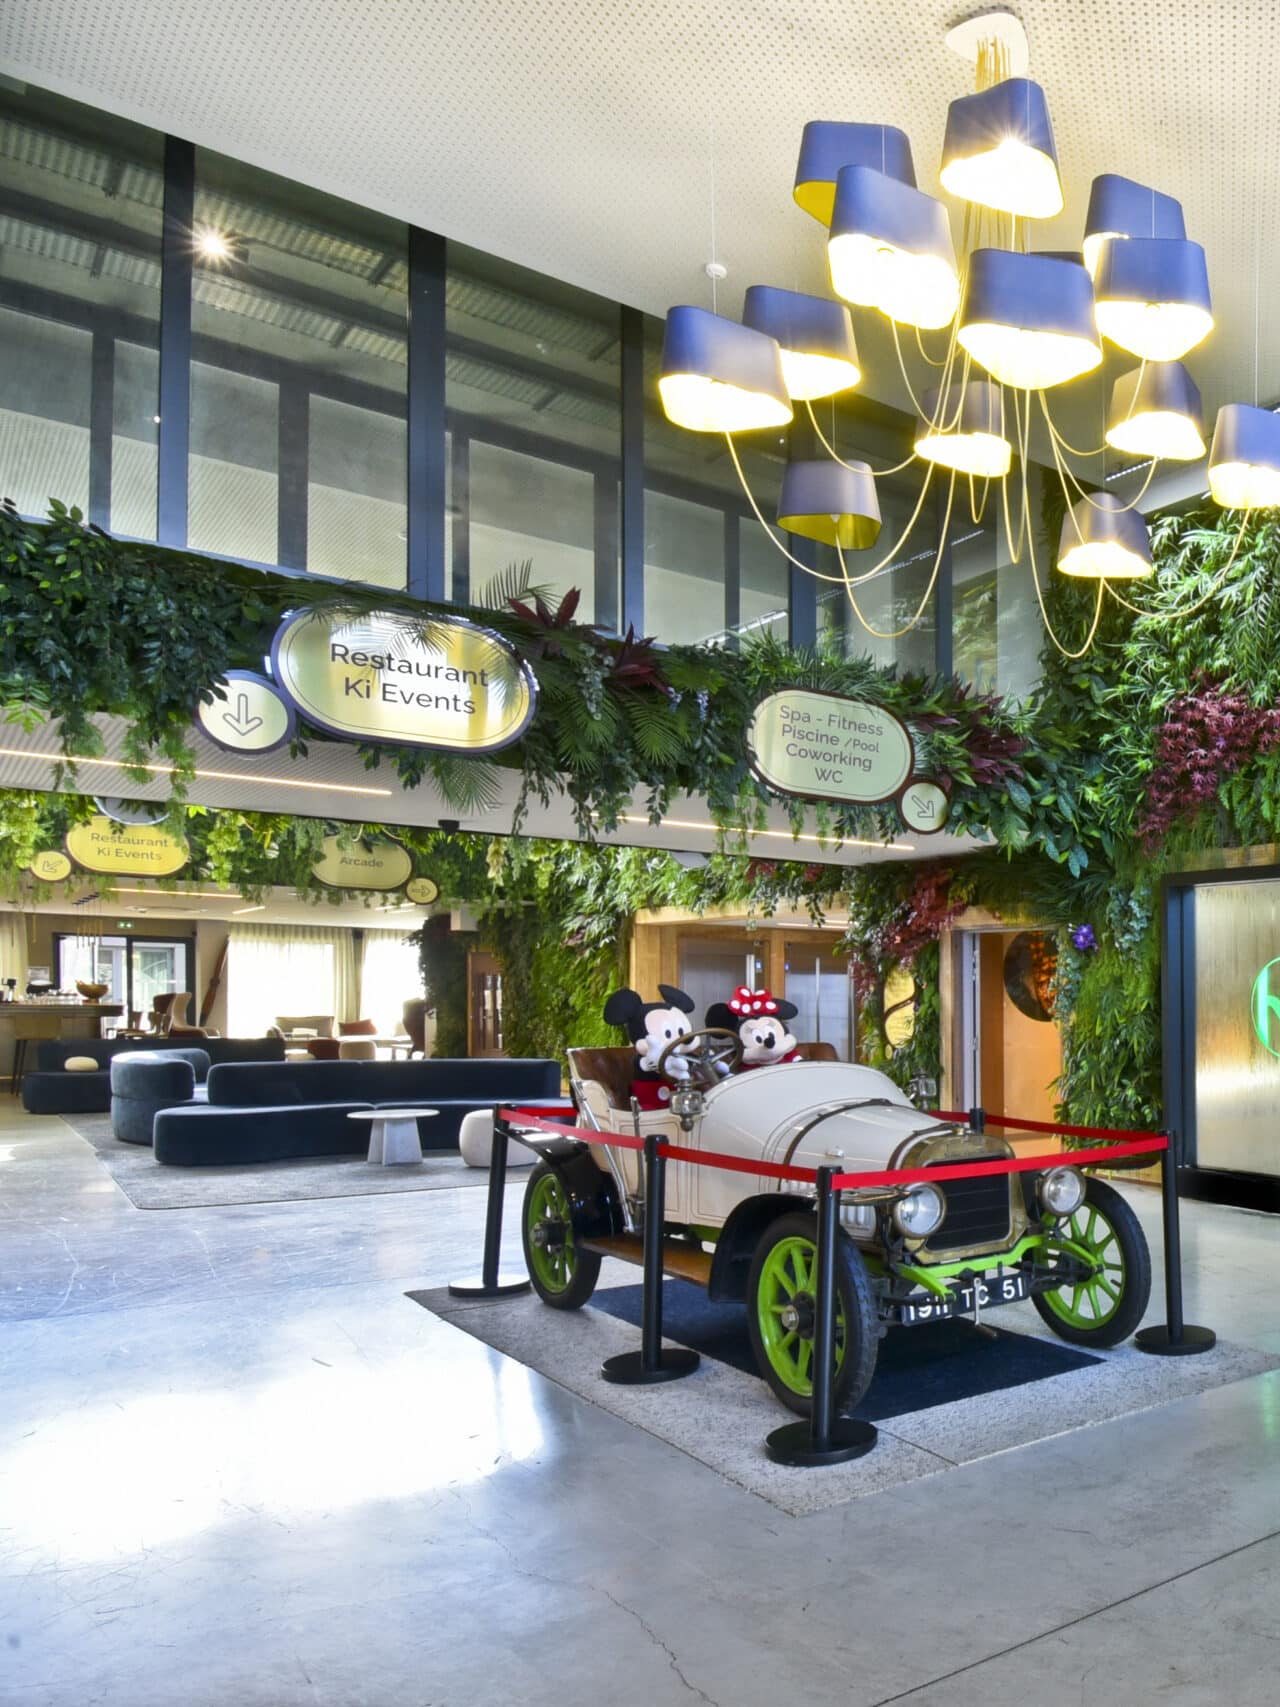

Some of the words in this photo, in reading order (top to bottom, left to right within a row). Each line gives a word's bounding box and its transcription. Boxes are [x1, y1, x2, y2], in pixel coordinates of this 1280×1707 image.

[331, 643, 489, 687] Restaurant
[344, 677, 371, 699] Ki
[381, 683, 477, 714] Events
[779, 705, 811, 723] Spa
[827, 713, 884, 736] Fitness
[781, 724, 840, 746] Piscine
[786, 743, 873, 772] Coworking
[815, 767, 843, 784] WC
[91, 832, 169, 848] Restaurant
[97, 847, 111, 857] Ki
[115, 848, 163, 861] Events
[340, 857, 384, 868] Arcade
[961, 1286, 990, 1309] TC
[1002, 1277, 1024, 1300] 51
